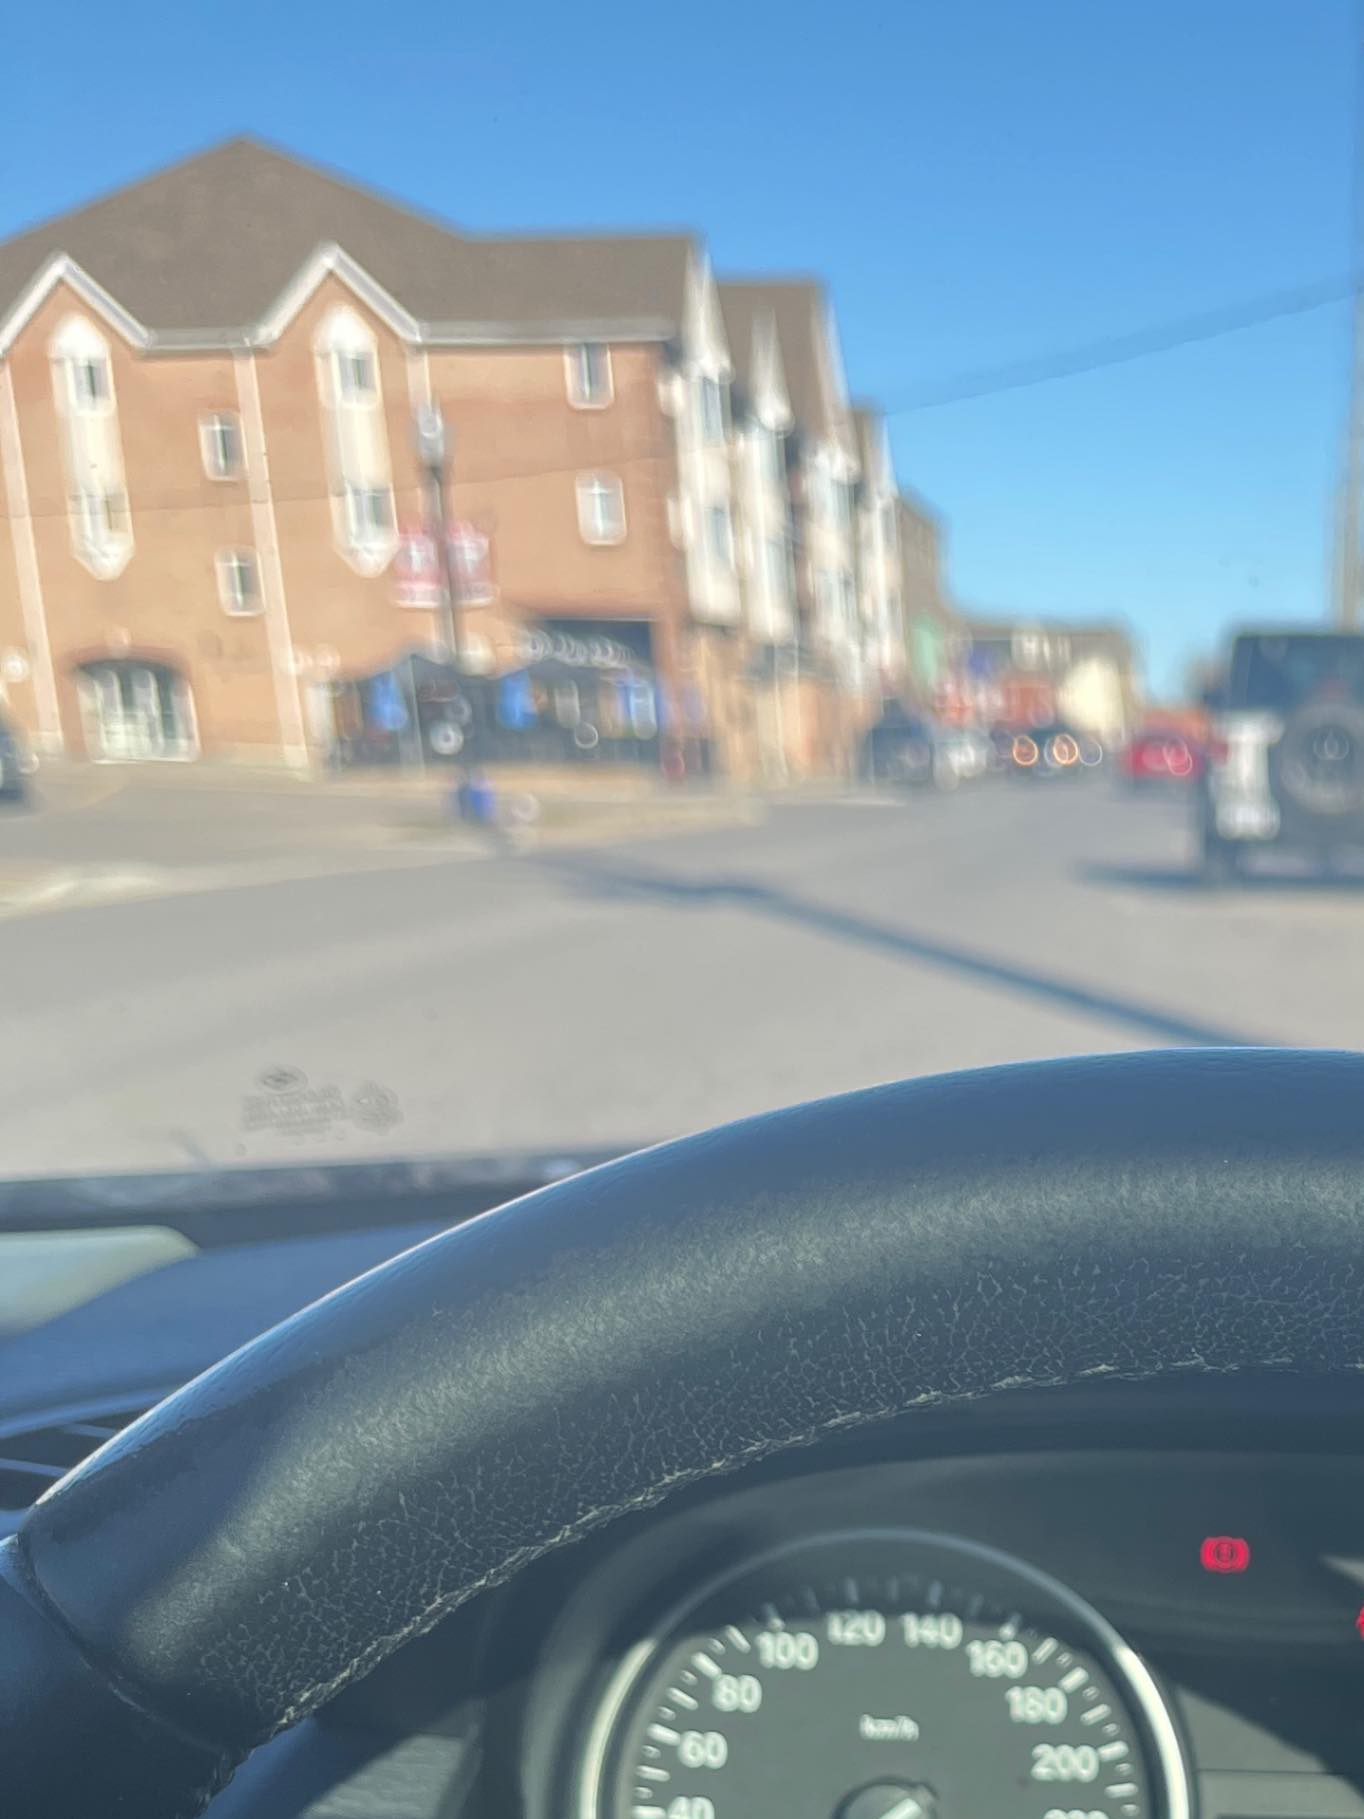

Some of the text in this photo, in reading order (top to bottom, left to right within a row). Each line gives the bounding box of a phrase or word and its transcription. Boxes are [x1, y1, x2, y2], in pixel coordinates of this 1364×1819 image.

[827, 1609, 886, 1647] 120
[903, 1612, 962, 1649] 140
[758, 1631, 818, 1671] 100
[966, 1638, 1028, 1678] 160
[712, 1674, 761, 1713] 80
[1005, 1685, 1067, 1725] 180
[859, 1713, 919, 1741] km/h
[678, 1730, 728, 1769] 60
[1031, 1744, 1098, 1783] 200
